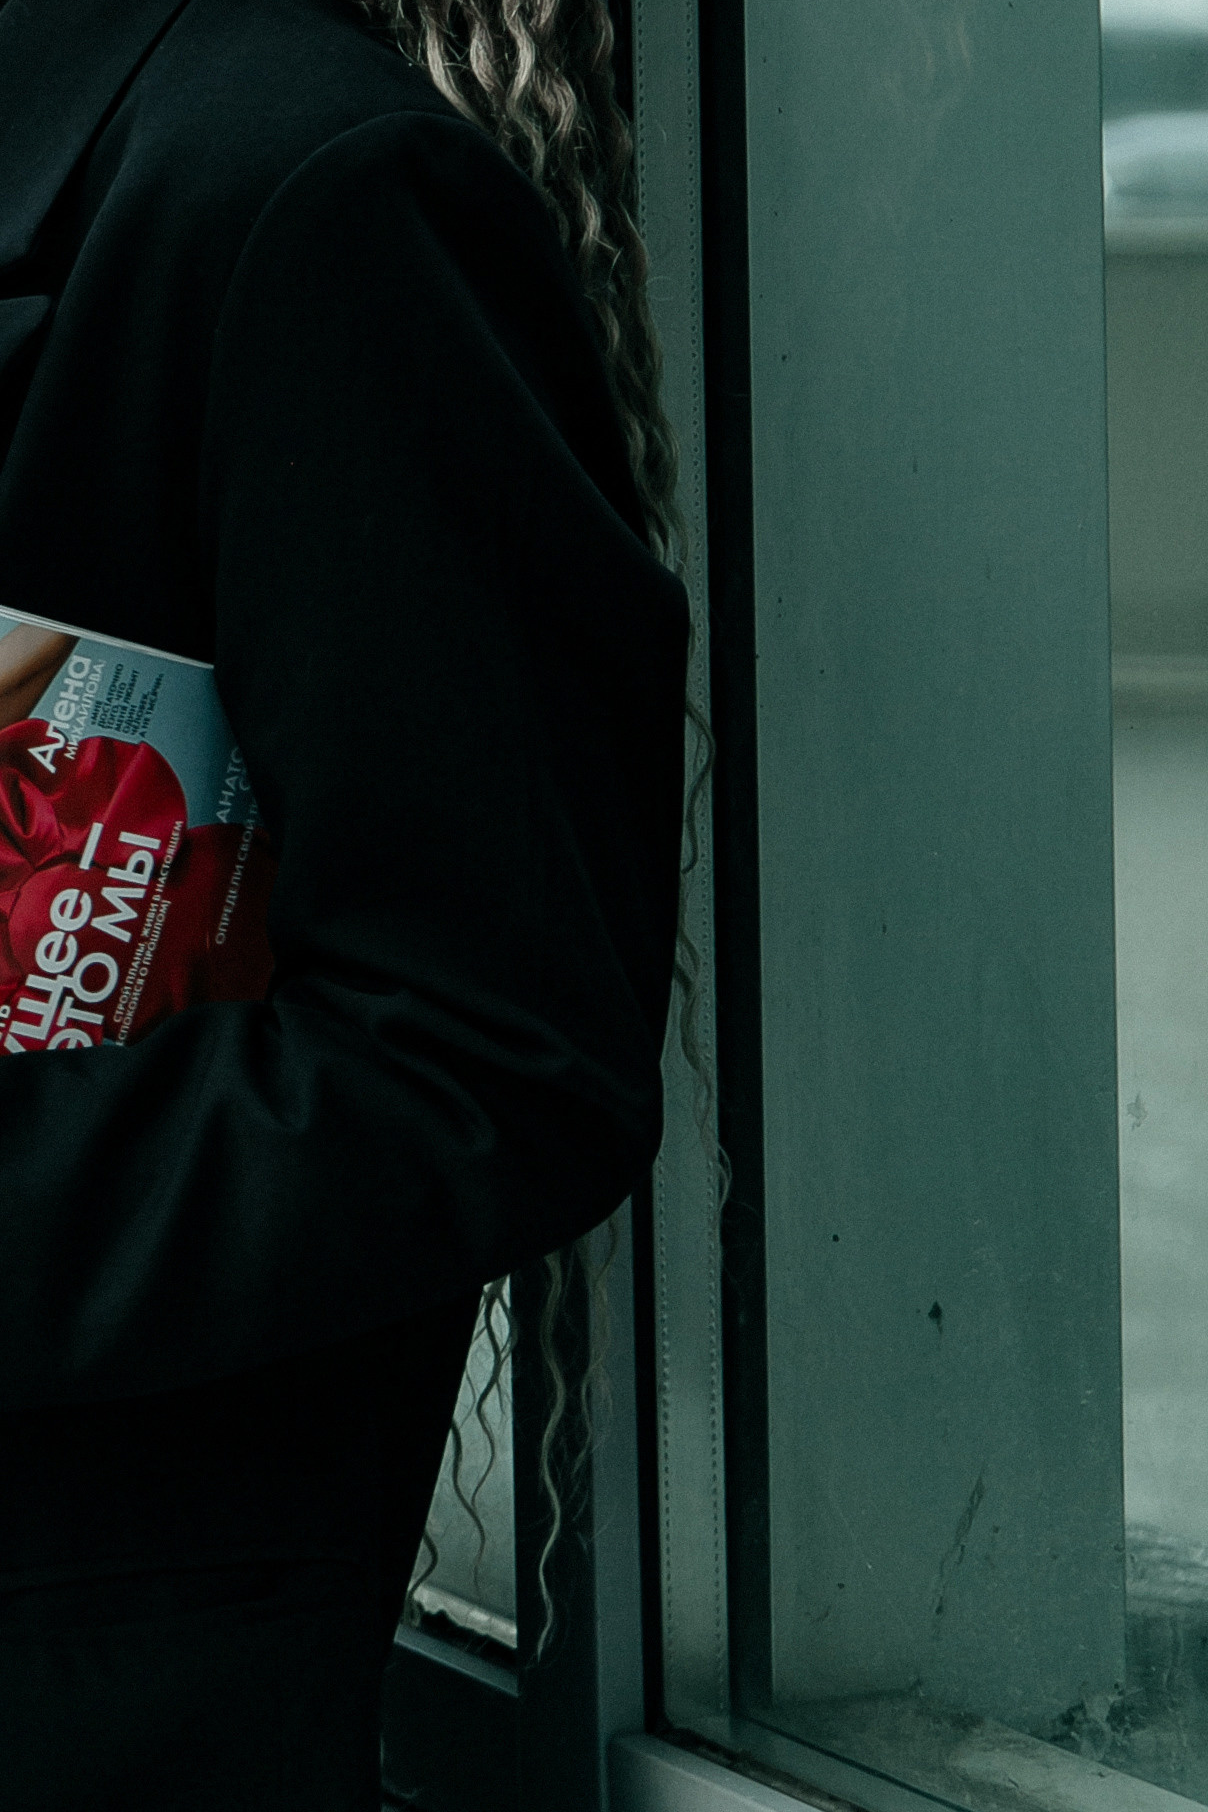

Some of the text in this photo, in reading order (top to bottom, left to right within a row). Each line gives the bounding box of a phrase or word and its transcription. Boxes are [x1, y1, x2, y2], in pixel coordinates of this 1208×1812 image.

[28, 652, 97, 773] Алена
[155, 821, 183, 892] НАСТОЯЩЕМ
[149, 893, 162, 903] В
[141, 903, 159, 937] ЖИВИ
[113, 986, 132, 1022] СТРОЙ
